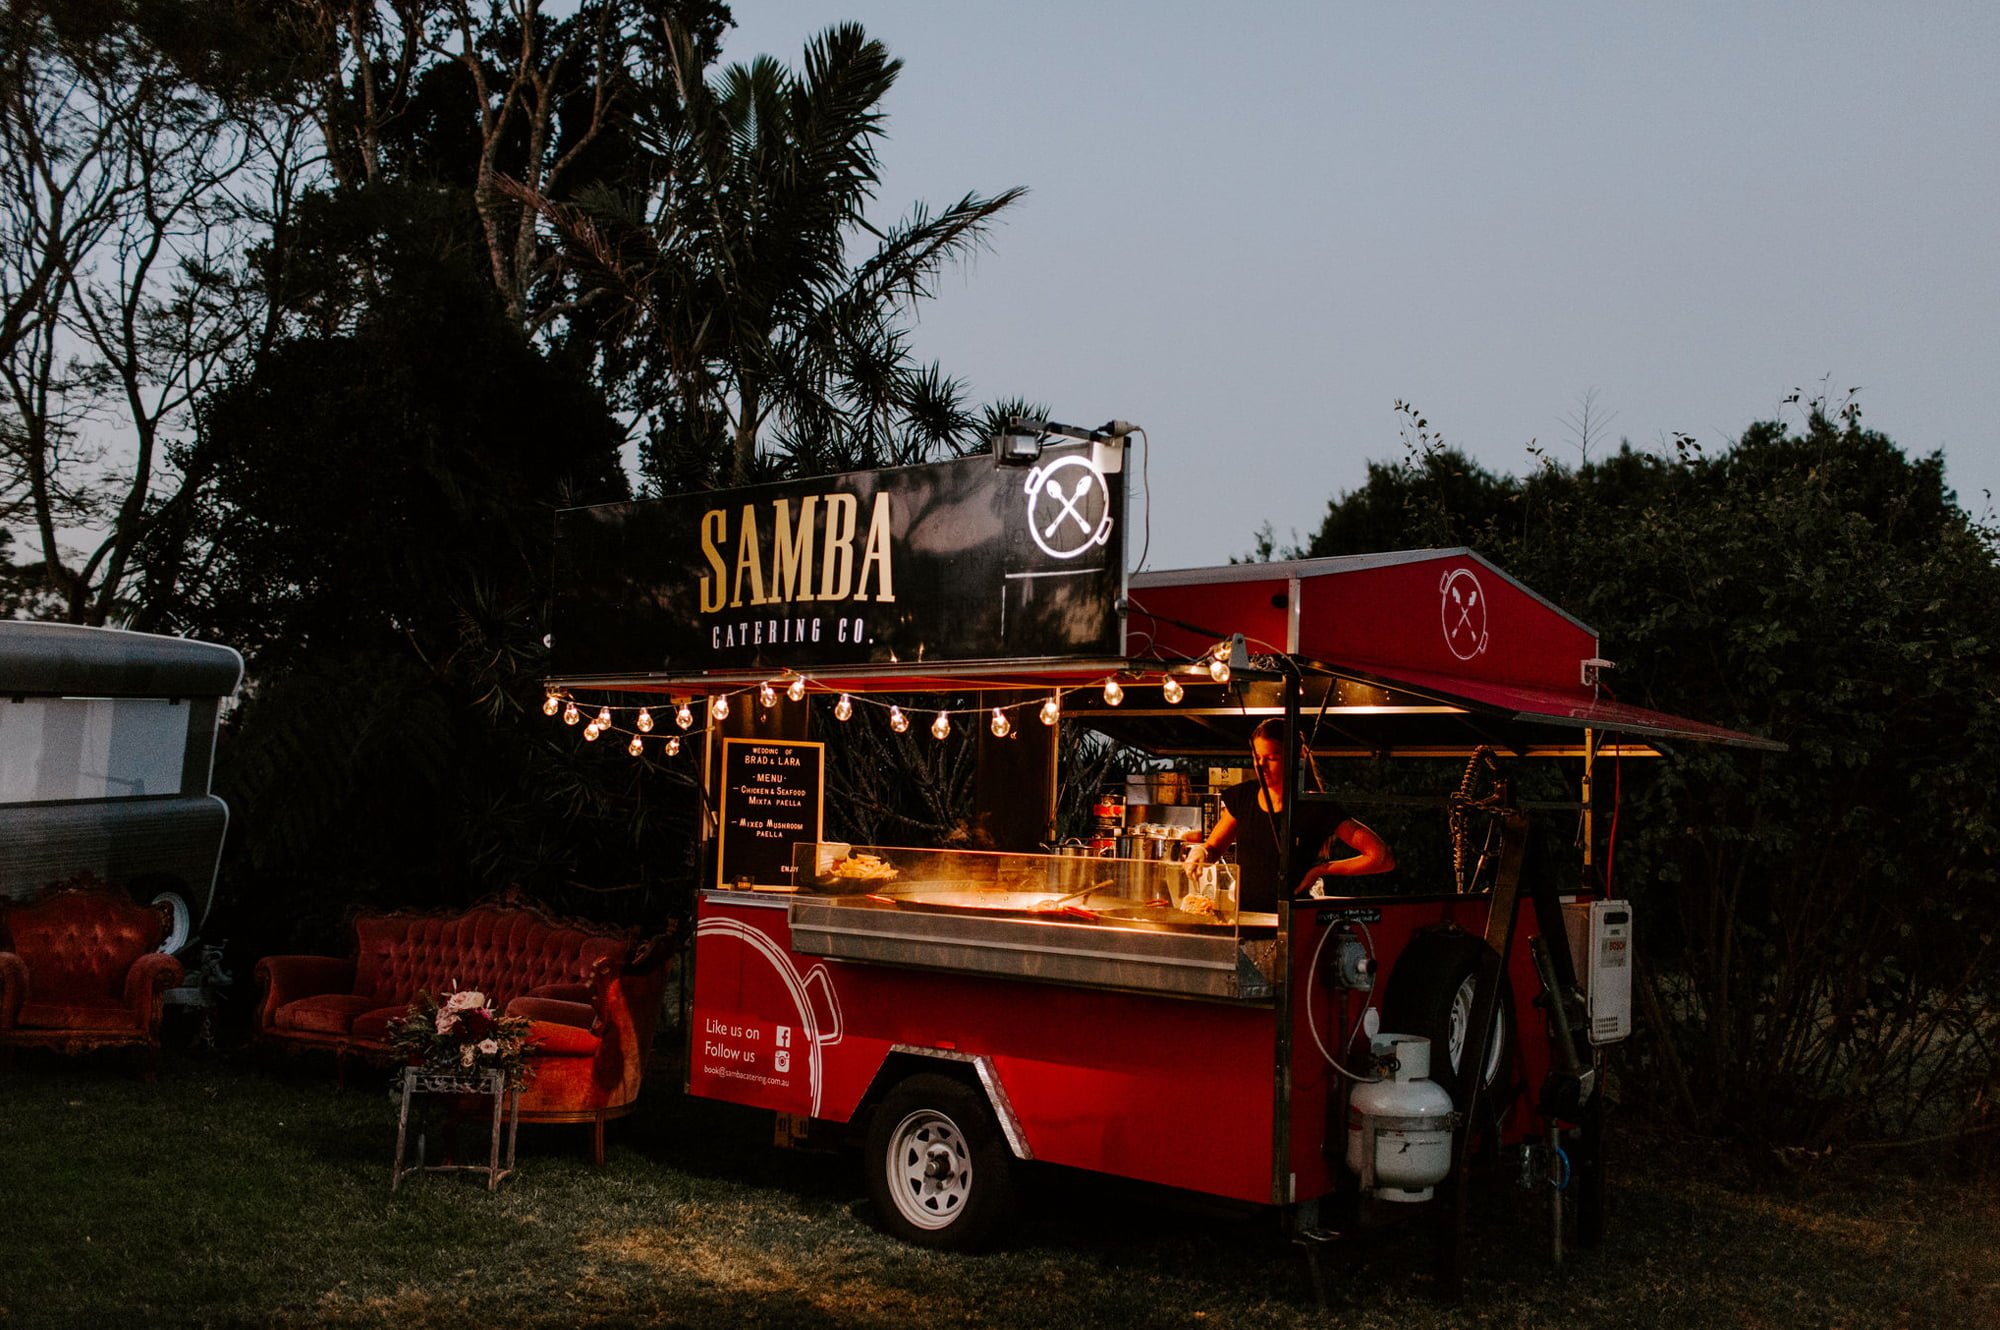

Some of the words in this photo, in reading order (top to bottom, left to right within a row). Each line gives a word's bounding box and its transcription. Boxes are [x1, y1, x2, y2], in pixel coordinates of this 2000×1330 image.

[700, 491, 896, 613] SAMBA
[712, 617, 821, 649] CATERING
[838, 617, 874, 643] CO.
[752, 747, 779, 755] WEDDING
[744, 755, 768, 765] BRAD
[778, 757, 801, 767] LARA
[740, 785, 769, 795] CHICKEN
[776, 787, 806, 797] SEAFOOD
[748, 796, 772, 806] MIXTA
[776, 799, 802, 807] PAELLA
[739, 818, 764, 828] MIXED
[766, 819, 804, 830] MUSHROOM
[756, 830, 783, 838] PAELLA
[706, 1018, 728, 1036] Like
[730, 1026, 743, 1038] us
[745, 1028, 760, 1040] on
[705, 1040, 741, 1060] Follow
[743, 1051, 756, 1063] us
[703, 1065, 790, 1087] book@sambacatering.com.au
